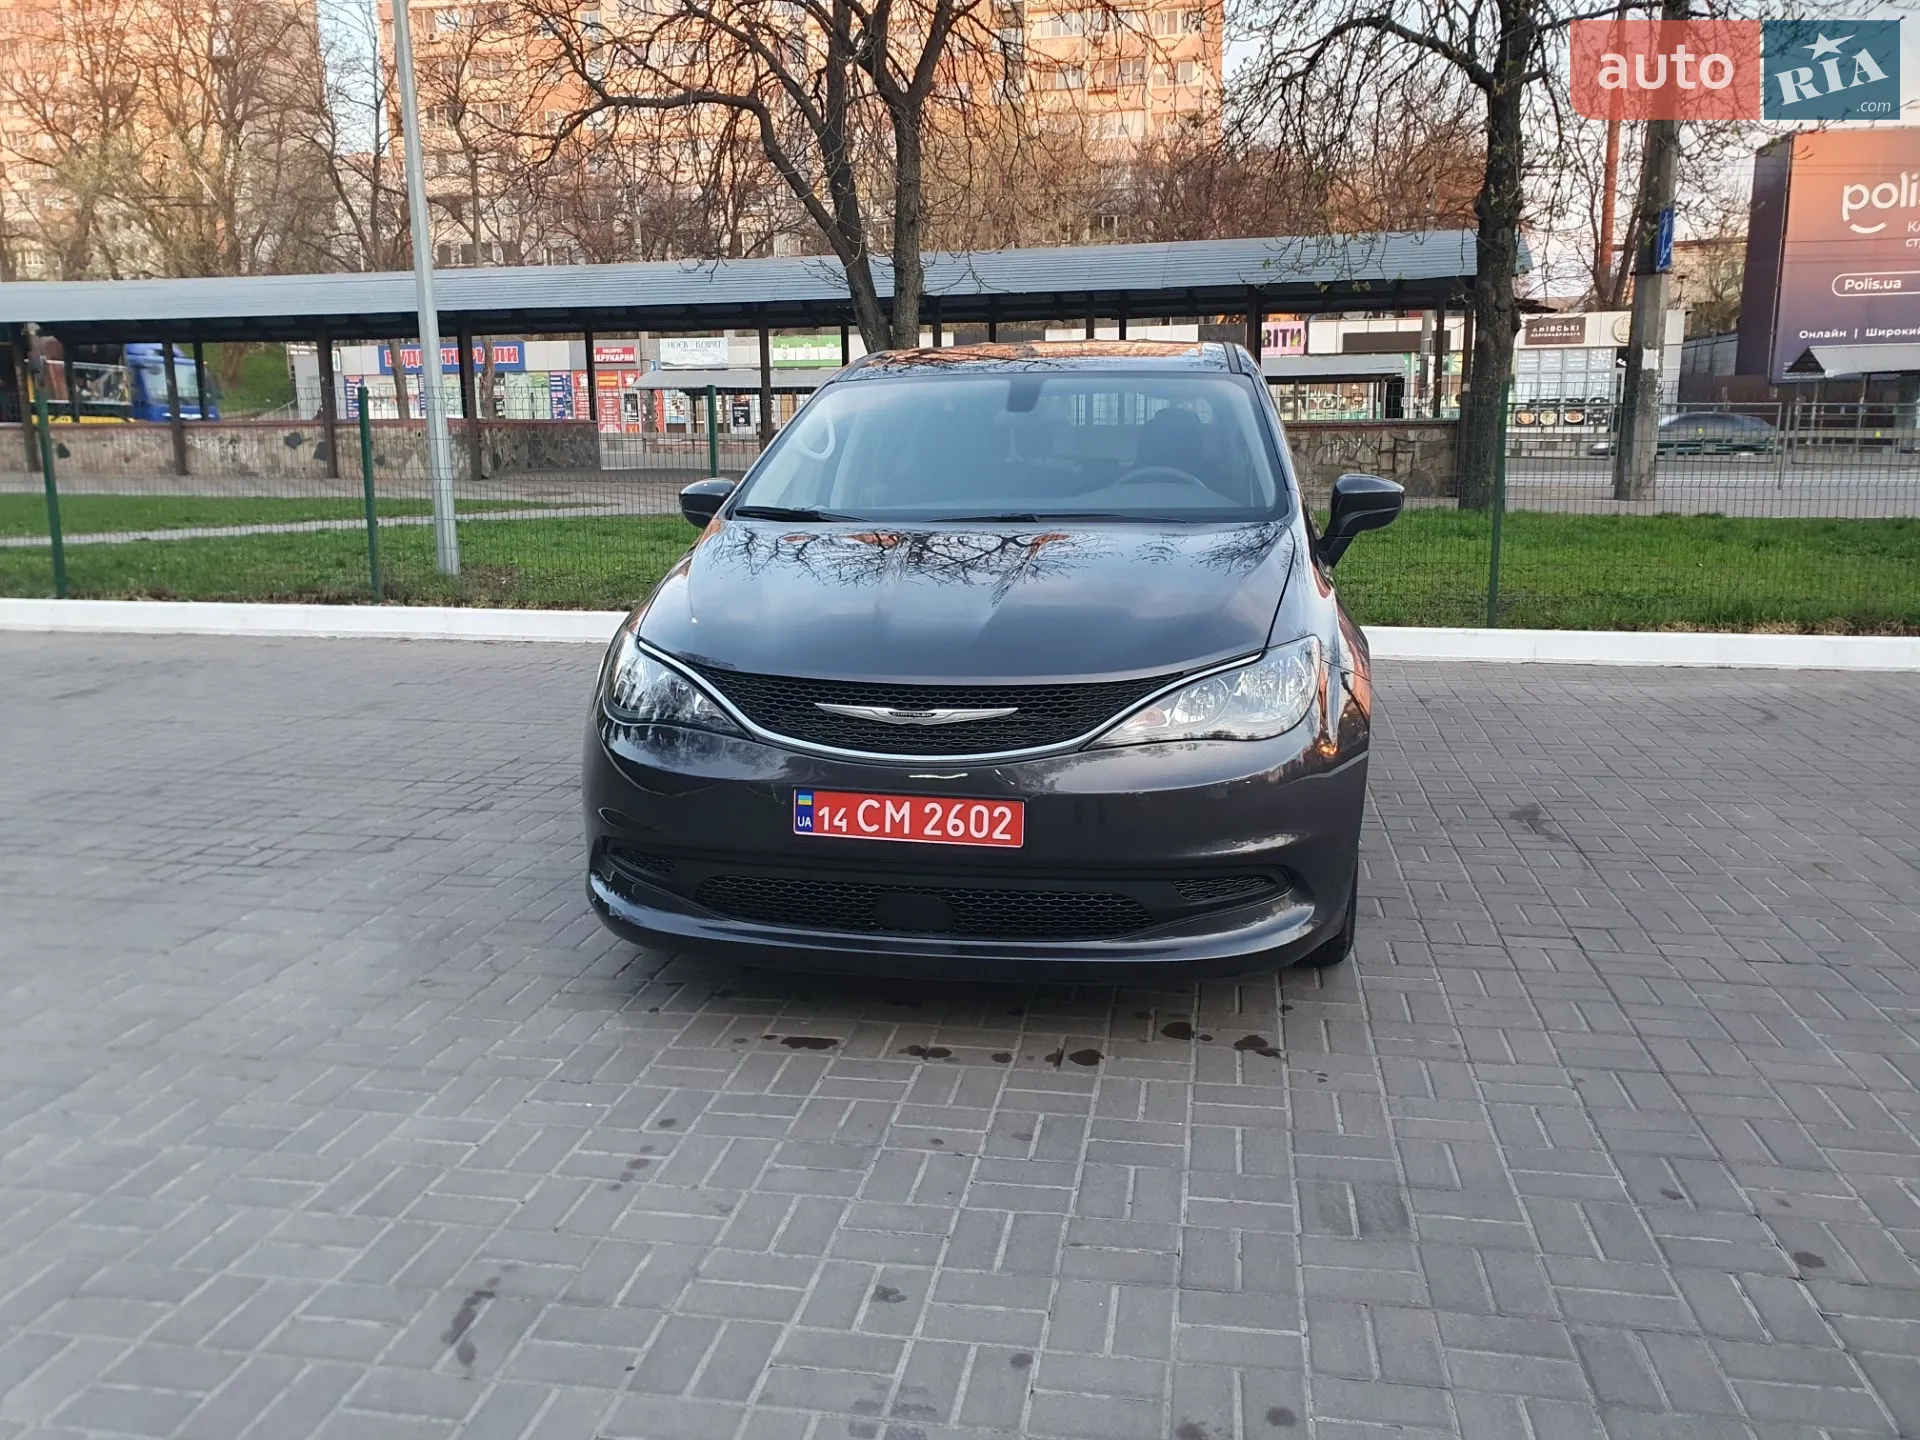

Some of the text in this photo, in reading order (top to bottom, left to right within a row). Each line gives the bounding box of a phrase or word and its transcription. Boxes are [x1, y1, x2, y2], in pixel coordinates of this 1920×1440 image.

[1842, 171, 1920, 222] poli
[1844, 277, 1902, 291] Polis.ua
[1261, 328, 1302, 348] ВІТИ
[1798, 328, 1847, 339] Онлайн
[797, 816, 812, 828] UA
[817, 798, 1013, 841] 14 CM 2602
